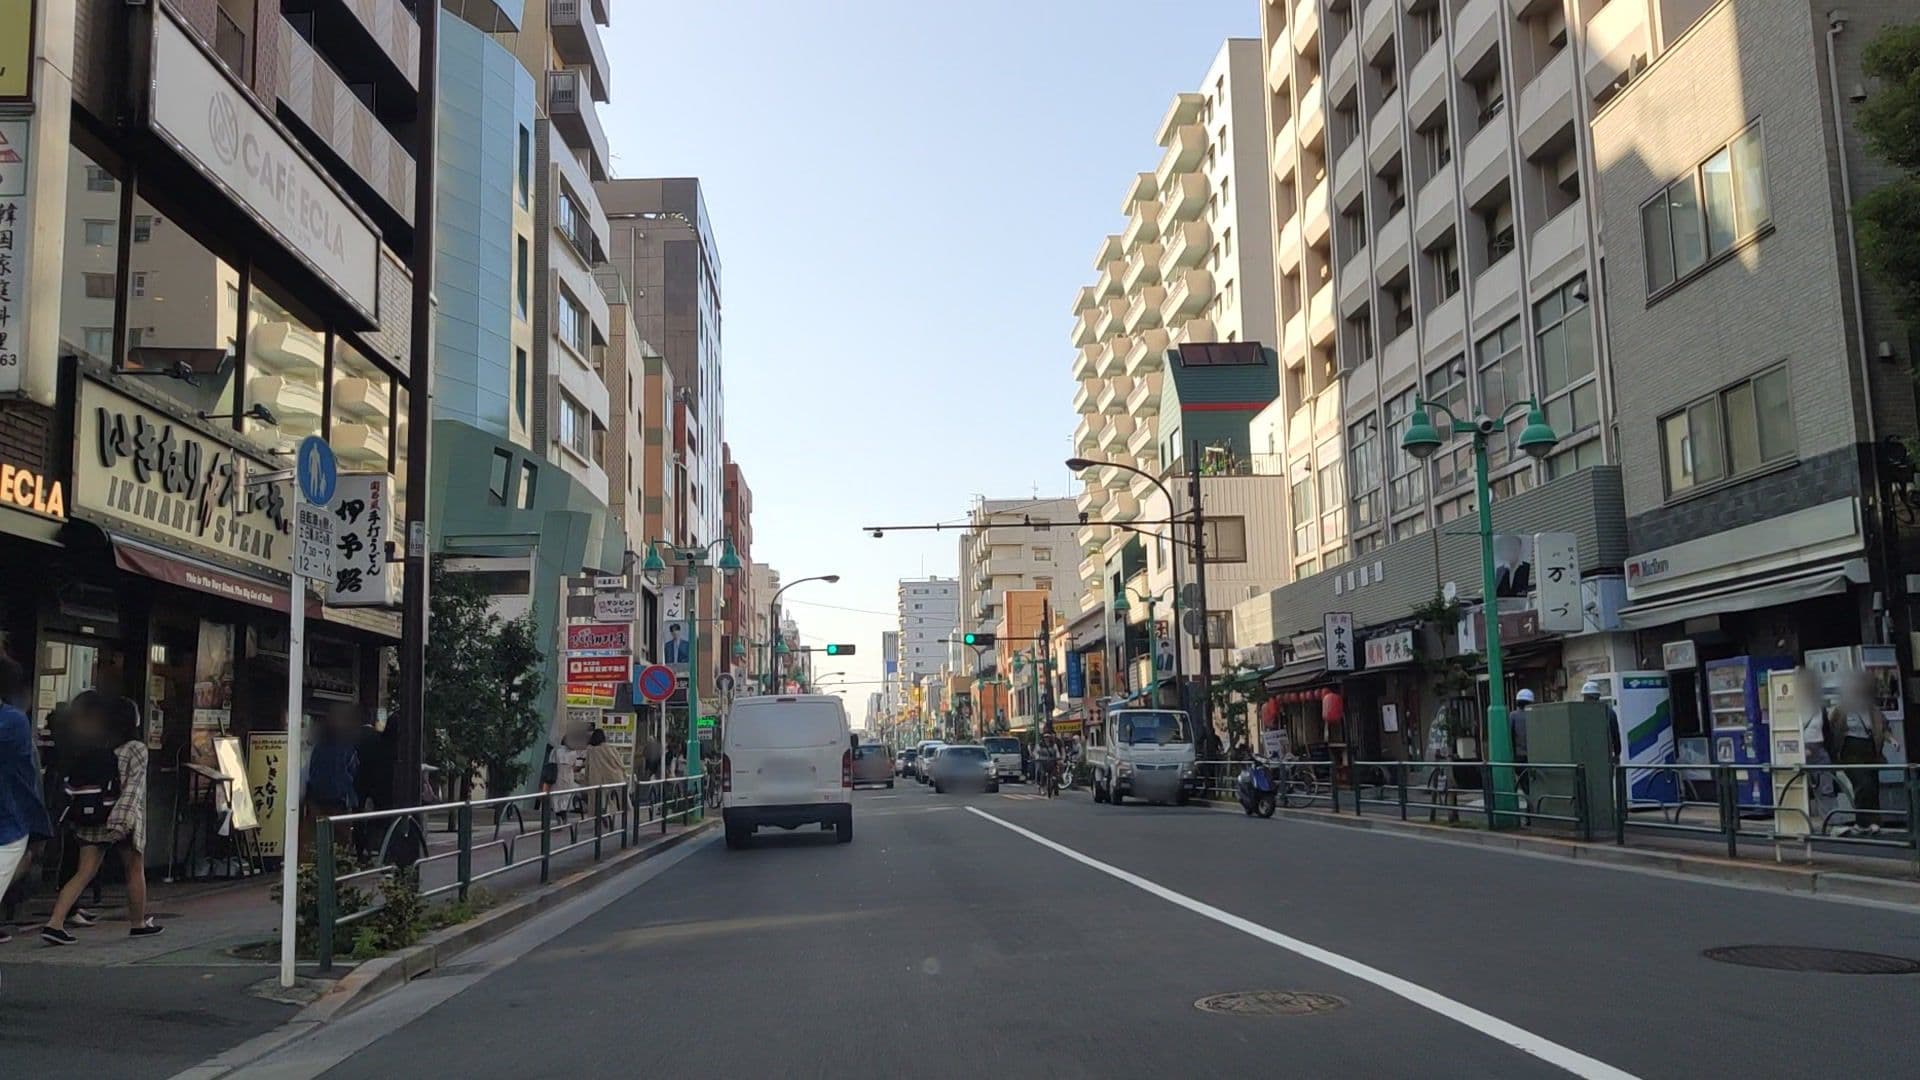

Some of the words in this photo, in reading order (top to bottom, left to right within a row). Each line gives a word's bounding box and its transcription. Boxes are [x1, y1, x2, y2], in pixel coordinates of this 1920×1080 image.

[299, 186, 344, 263] ECLA
[0, 464, 64, 518] ECLA
[107, 475, 195, 533] IKINARI
[214, 515, 274, 560] STEAK
[335, 499, 364, 593] 伊予路
[1334, 625, 1349, 668] 中央苑
